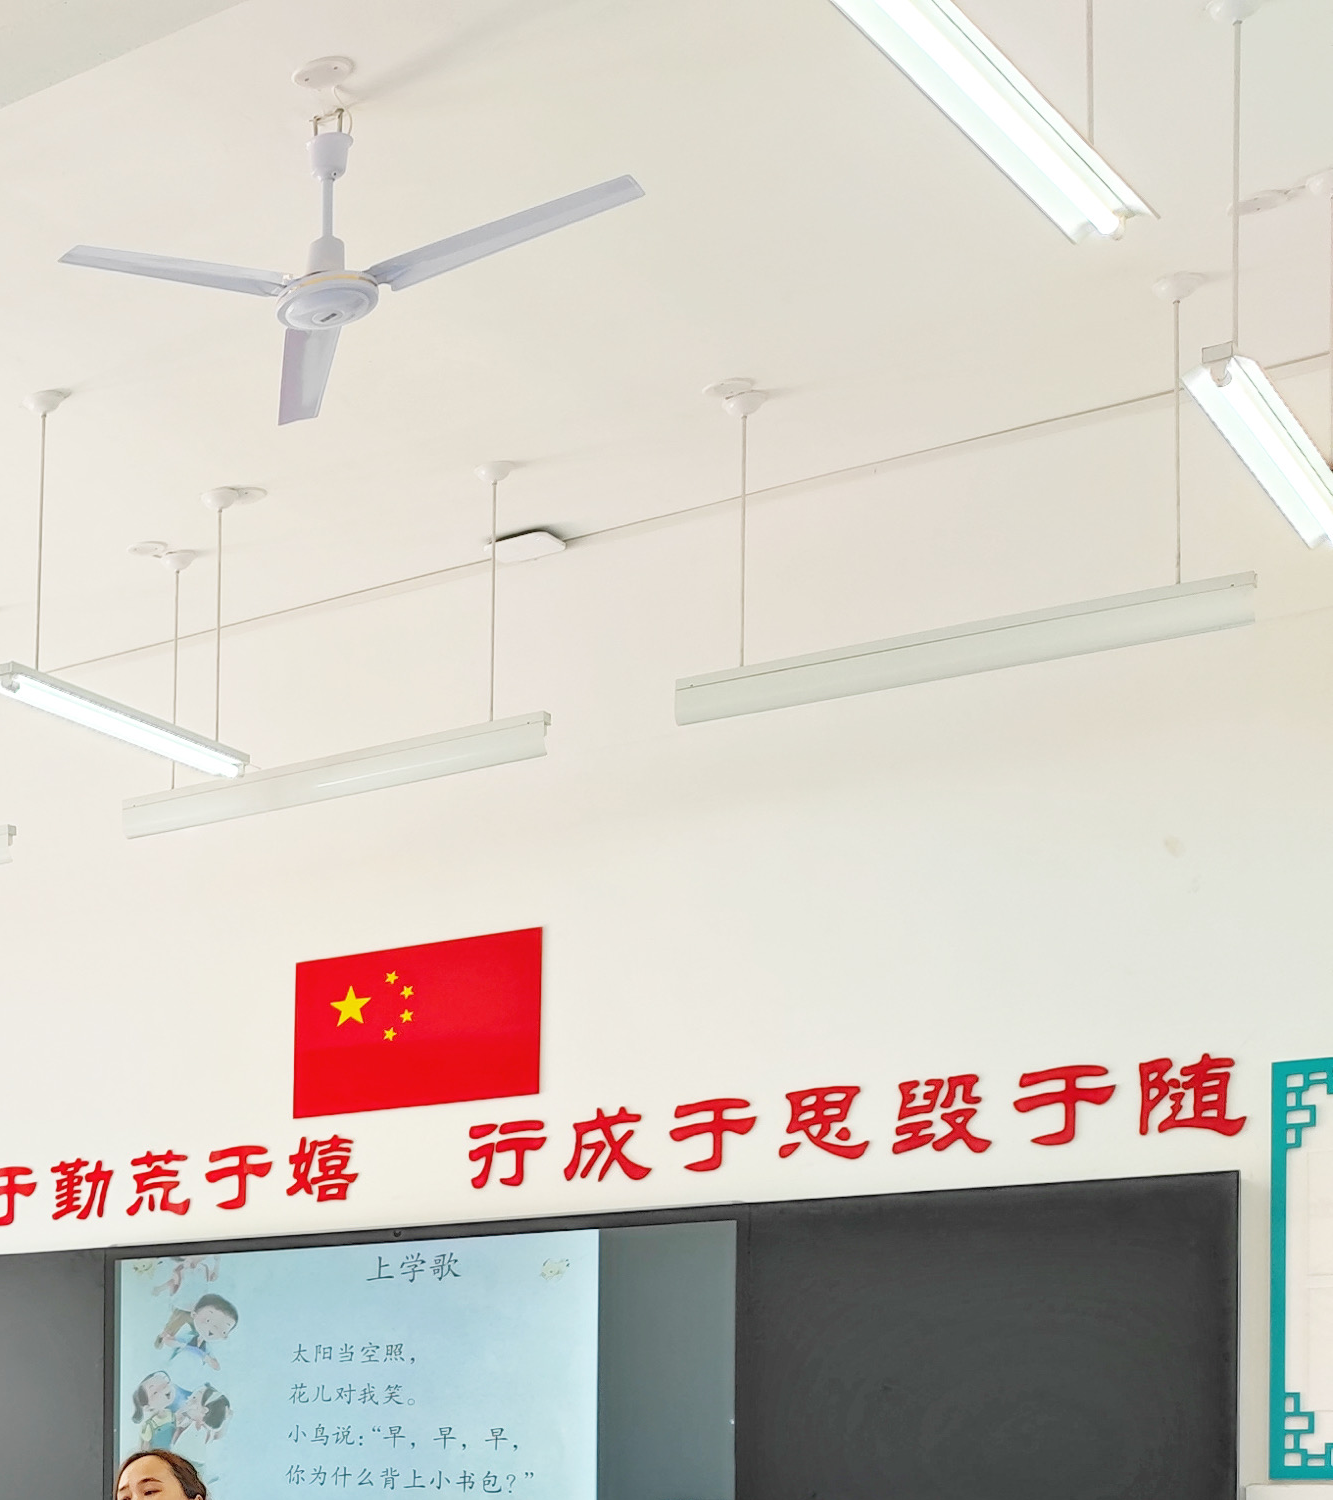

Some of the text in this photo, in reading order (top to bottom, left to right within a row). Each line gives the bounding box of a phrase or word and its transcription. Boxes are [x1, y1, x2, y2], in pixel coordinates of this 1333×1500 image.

[467, 1053, 1248, 1189] 行成于思毁于随
[365, 1251, 462, 1283] 上学歌
[291, 1342, 417, 1365] 太阳当空照，
[288, 1382, 416, 1406] 花儿对我笑。
